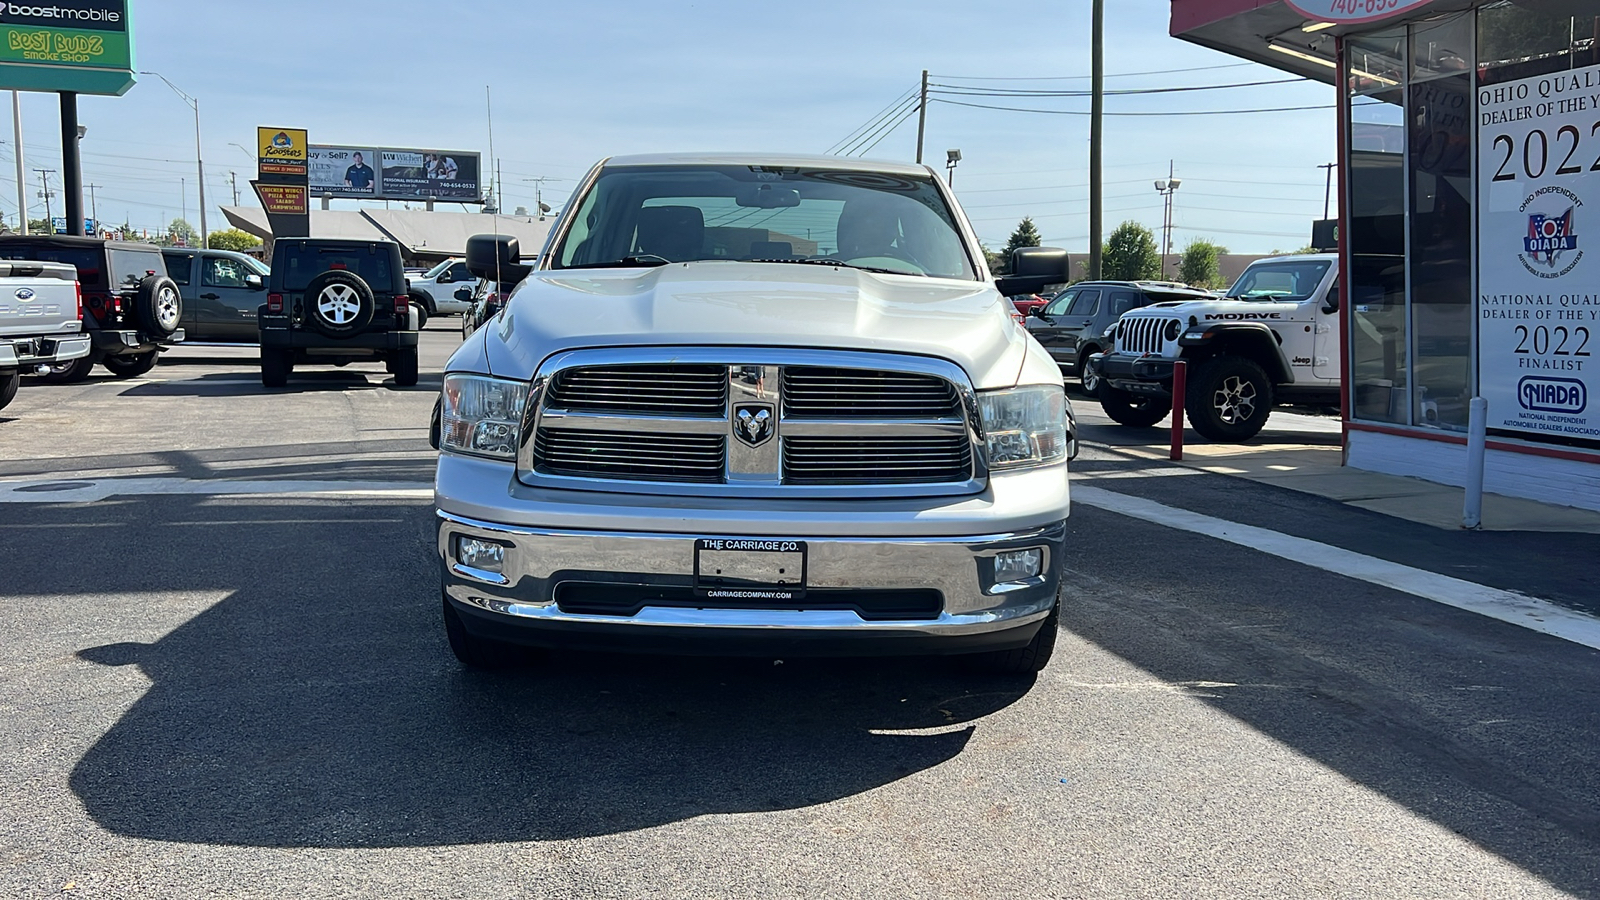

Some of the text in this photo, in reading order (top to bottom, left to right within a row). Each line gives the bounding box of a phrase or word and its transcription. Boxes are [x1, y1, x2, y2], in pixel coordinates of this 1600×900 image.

[23, 51, 90, 63] SMOKE SHOP
[1480, 83, 1529, 106] OHIO
[1481, 105, 1532, 126] DEALER
[1535, 102, 1554, 118] OF
[1557, 96, 1587, 114] THE
[328, 151, 348, 159] Sell?
[1519, 186, 1584, 213] OHIO INDEPENDENT
[1530, 237, 1568, 251] OIADA
[1517, 250, 1584, 279] AUTOMOBILE DEALERS ASSOCIATION
[1481, 294, 1553, 305] NATIONAL
[1204, 312, 1281, 320] MOJAVE
[1483, 309, 1530, 320] DEALER
[1535, 310, 1552, 320] OF
[1557, 310, 1583, 320] THE
[1513, 325, 1591, 357] 2022
[1292, 356, 1311, 364] Jeep
[1519, 358, 1584, 371] FINALIST
[1523, 383, 1580, 406] NIADA
[1518, 412, 1587, 425] NATIONAL INDEPENDENT
[1503, 420, 1537, 429] AUTOMOBILE
[1538, 423, 1563, 432] DEALERS
[703, 539, 799, 551] THE CARRIAGE CO.
[707, 590, 792, 599] CARRIAGECOMPANY.COM
